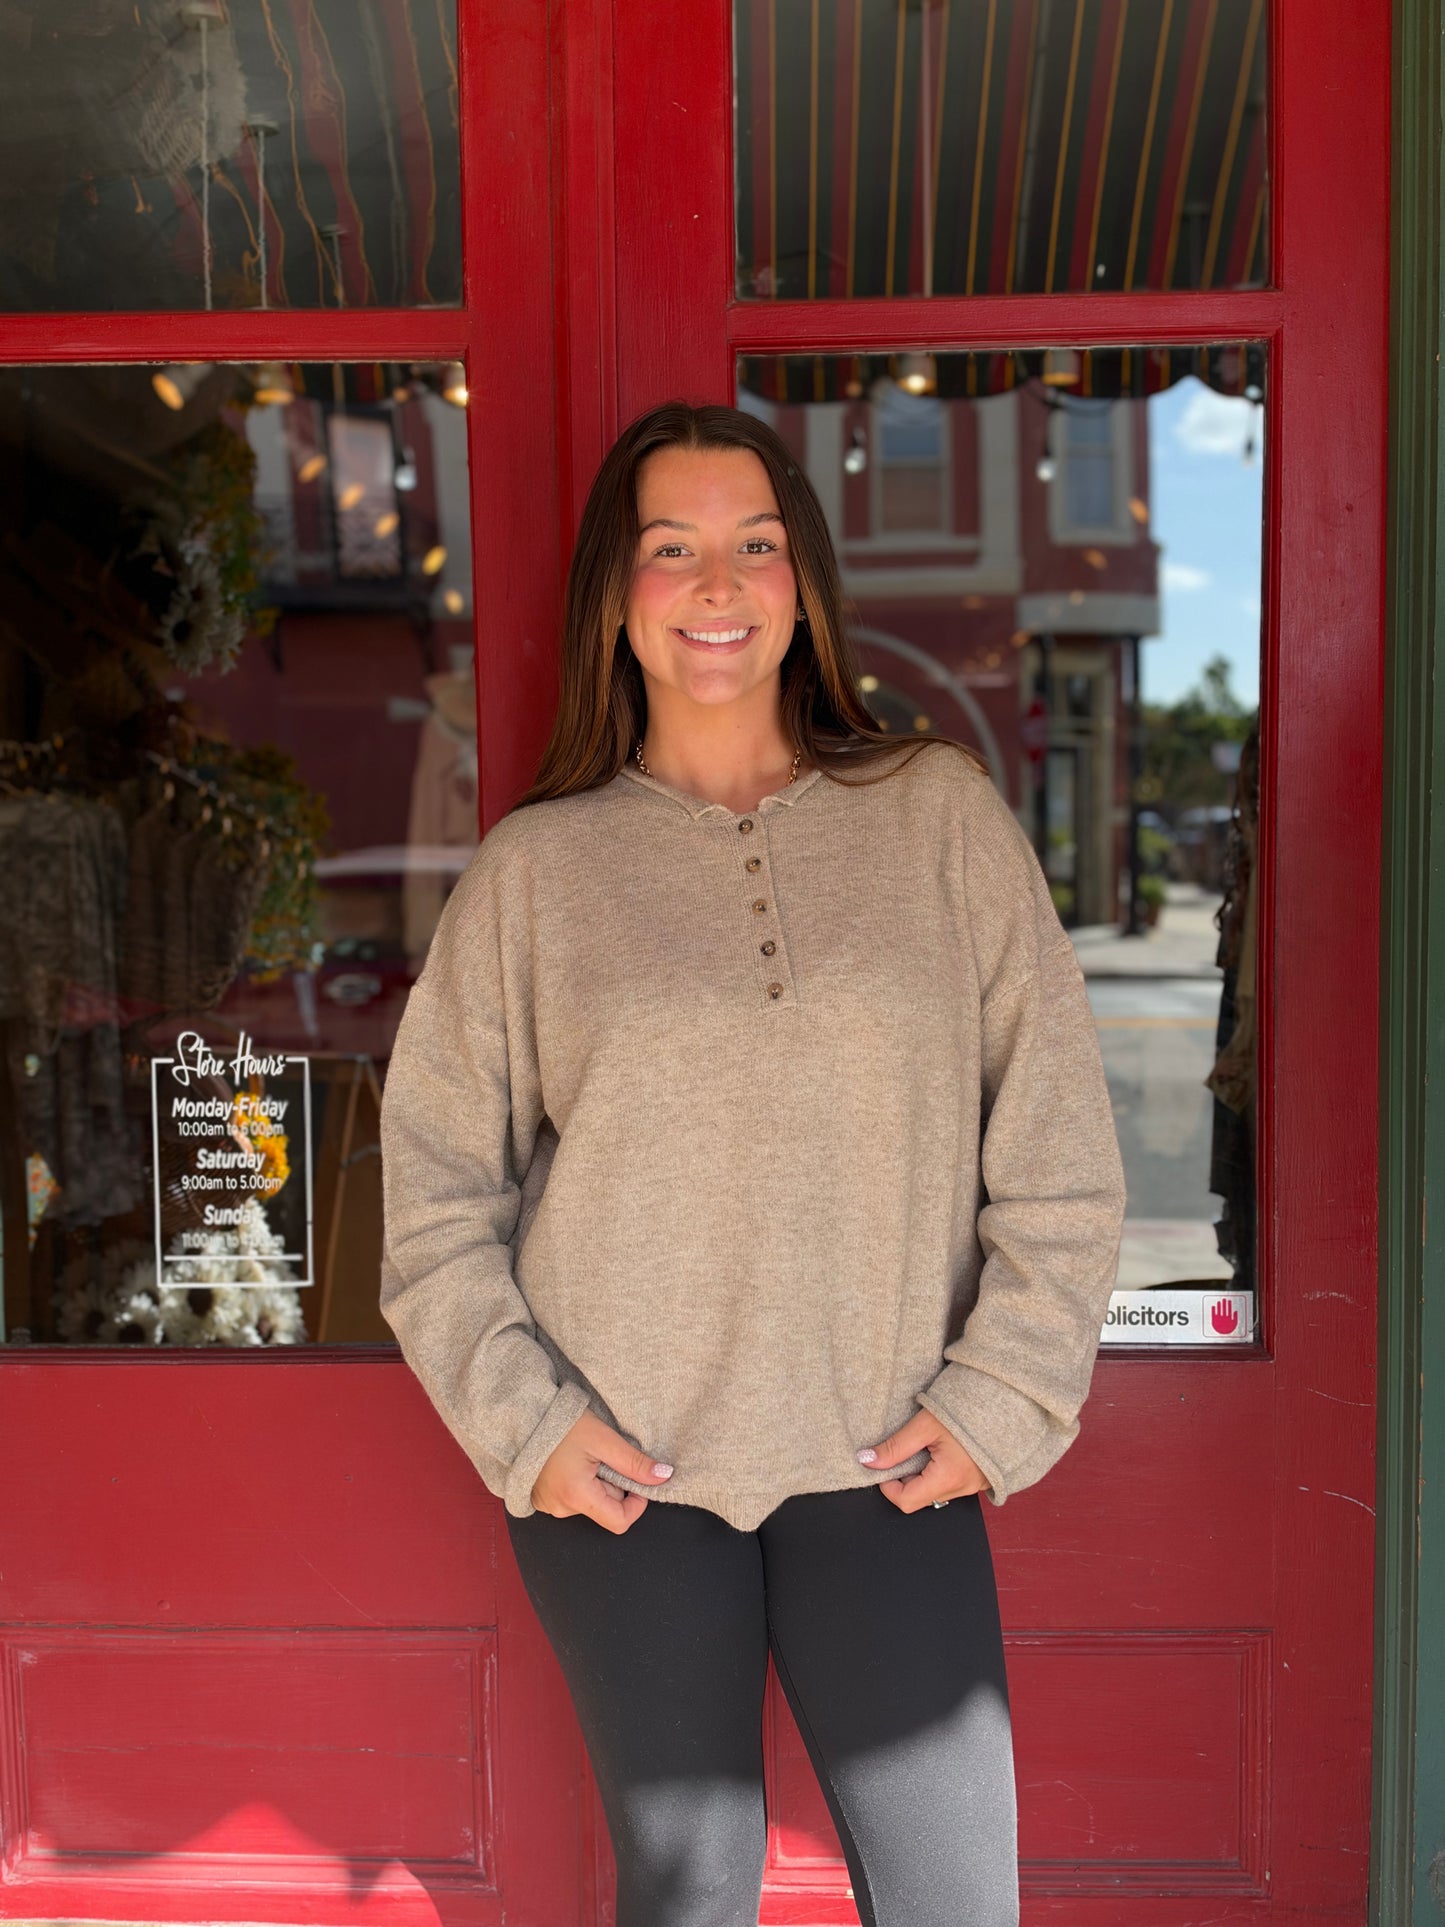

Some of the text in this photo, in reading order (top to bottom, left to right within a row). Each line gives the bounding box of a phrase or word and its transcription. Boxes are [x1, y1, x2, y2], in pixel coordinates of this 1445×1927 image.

[171, 1030, 286, 1087] Store Hours
[171, 1095, 288, 1121] Monday-Friday
[177, 1121, 224, 1136] 10:00am
[226, 1122, 239, 1136] to
[195, 1148, 266, 1172] Saturday
[181, 1175, 224, 1190] 9:00am
[225, 1175, 238, 1190] to
[202, 1204, 255, 1226] Sunda
[1104, 1306, 1190, 1326] olicitors
